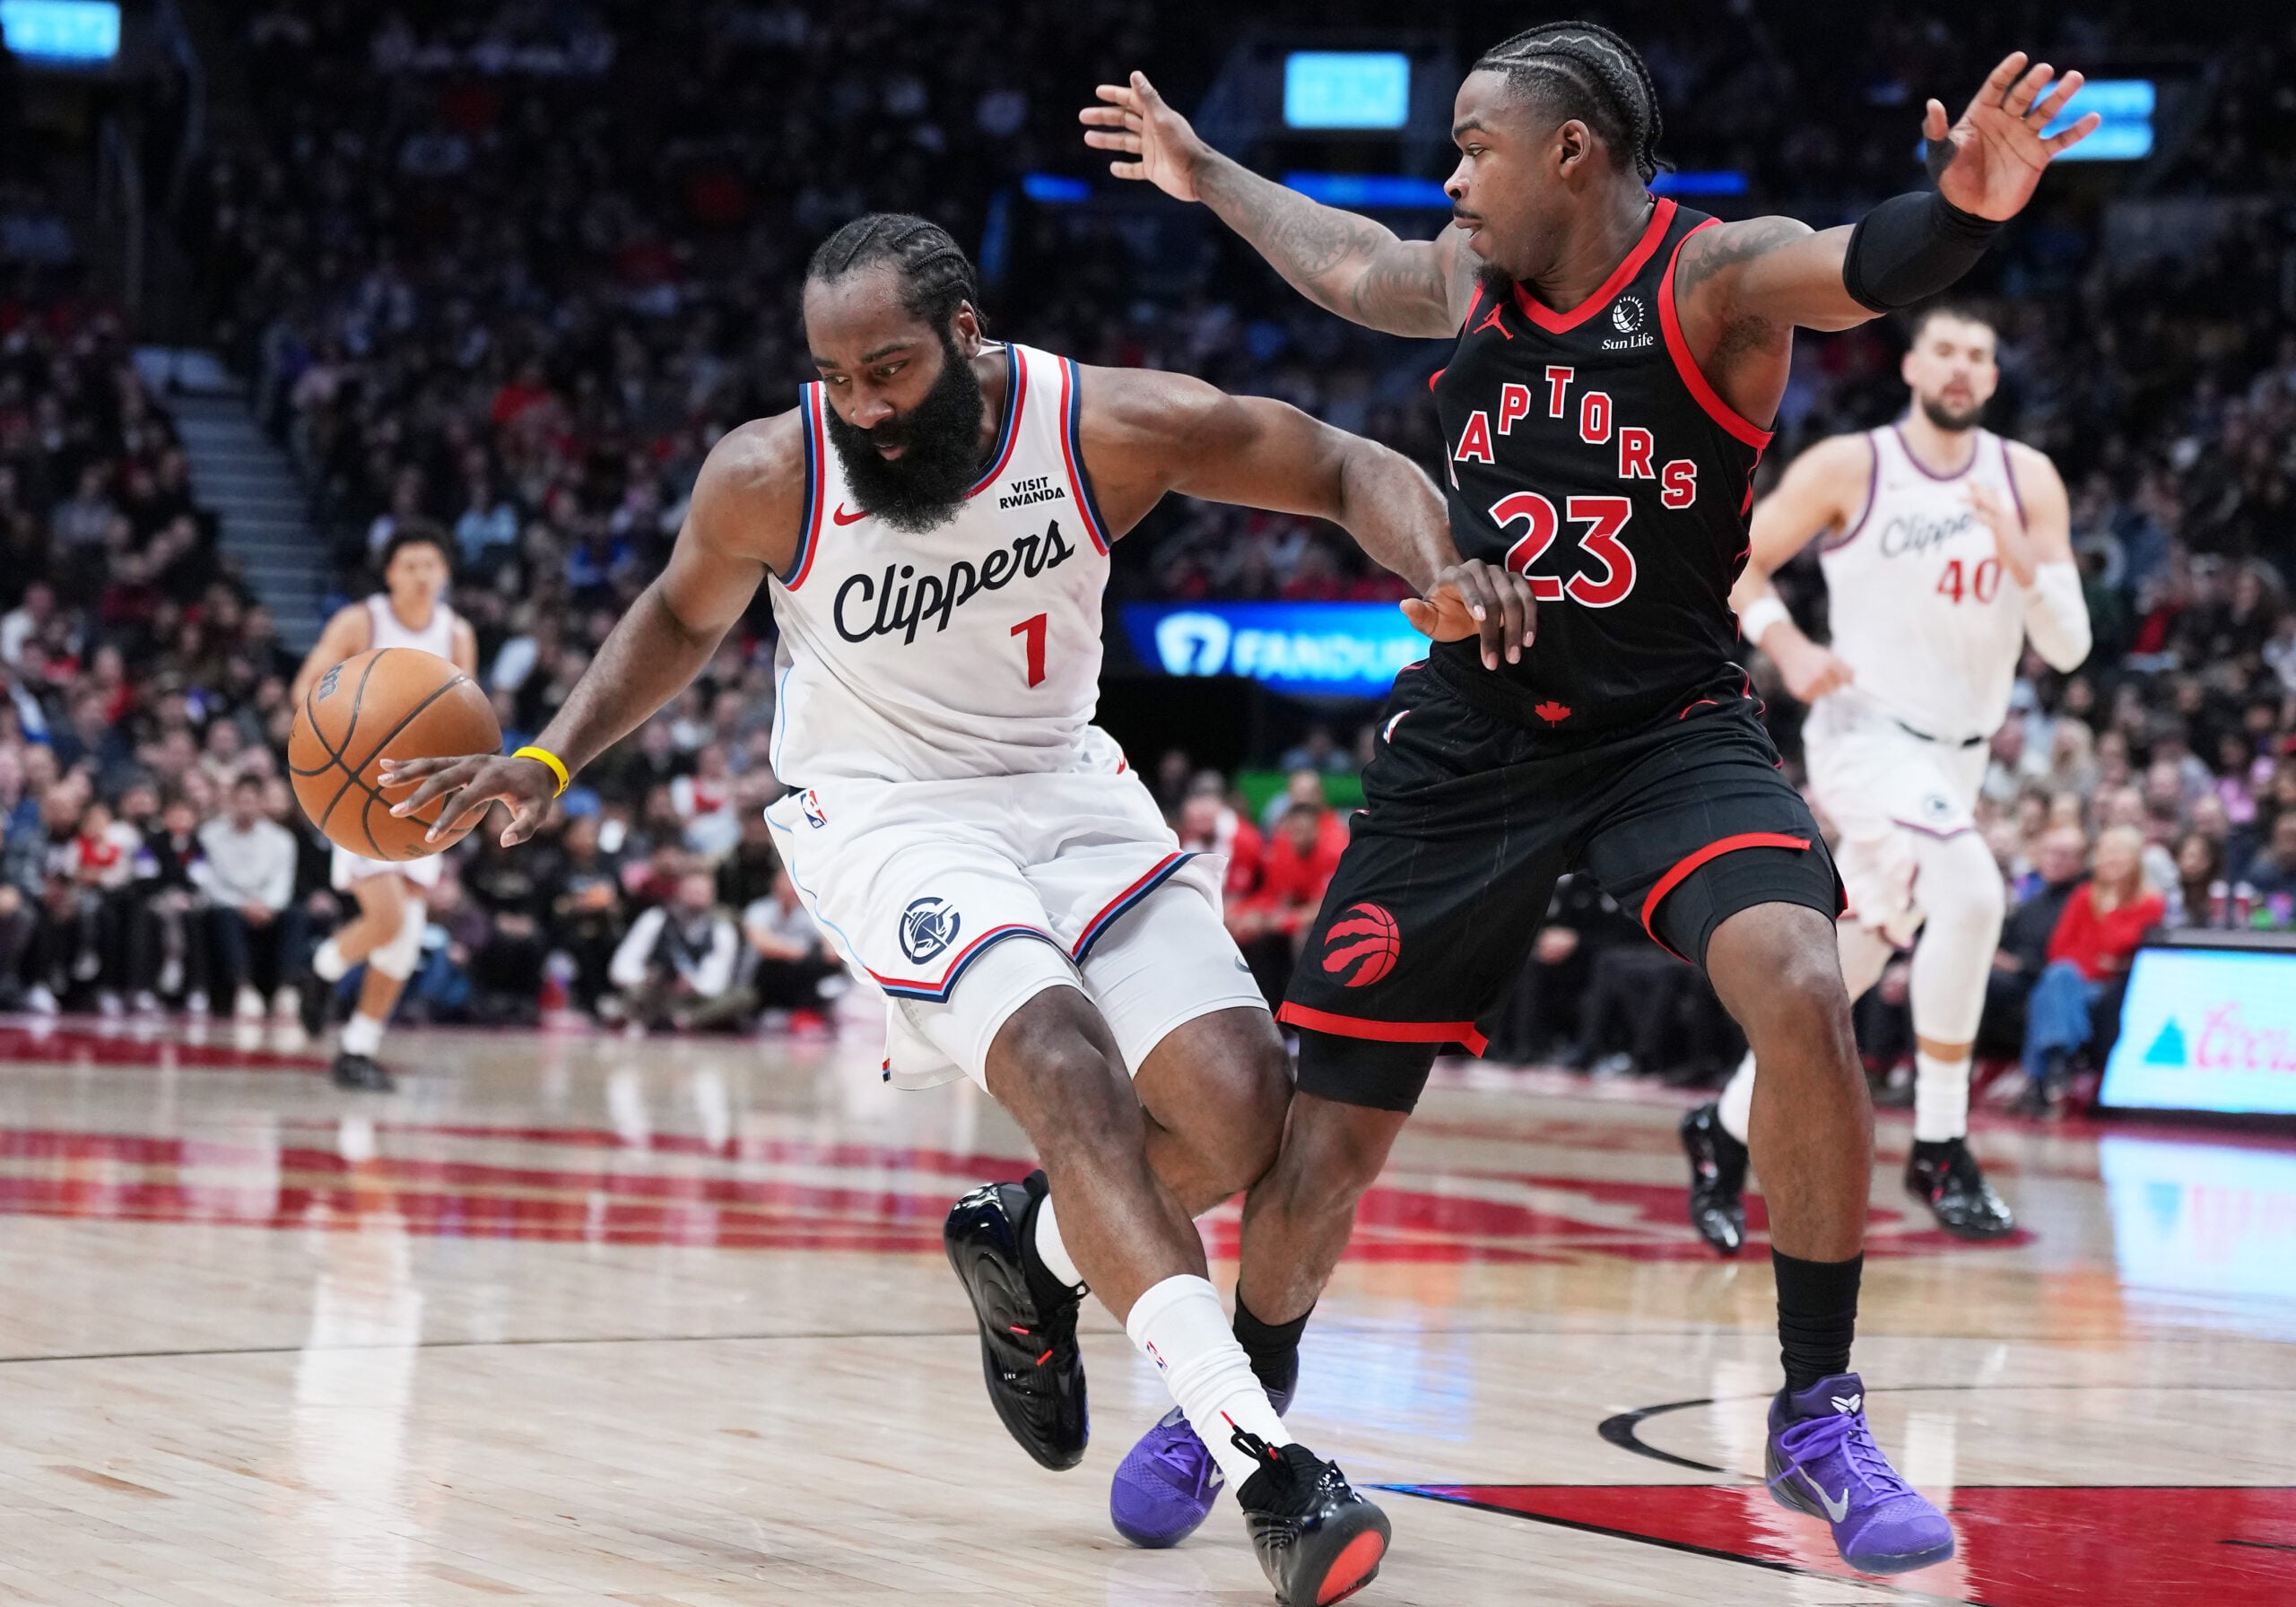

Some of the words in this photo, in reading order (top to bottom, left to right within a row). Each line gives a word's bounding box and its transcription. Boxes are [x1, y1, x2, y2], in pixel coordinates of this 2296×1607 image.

[1602, 339, 1628, 350] Sun
[1631, 332, 1654, 348] Life
[1446, 365, 1697, 509] APTORS
[999, 487, 1065, 509] RWANDA
[1011, 476, 1048, 493] VISIT
[1488, 491, 1637, 608] 23
[833, 519, 1075, 646] Clippers
[1936, 558, 2002, 604] 40
[1010, 612, 1048, 688] 1
